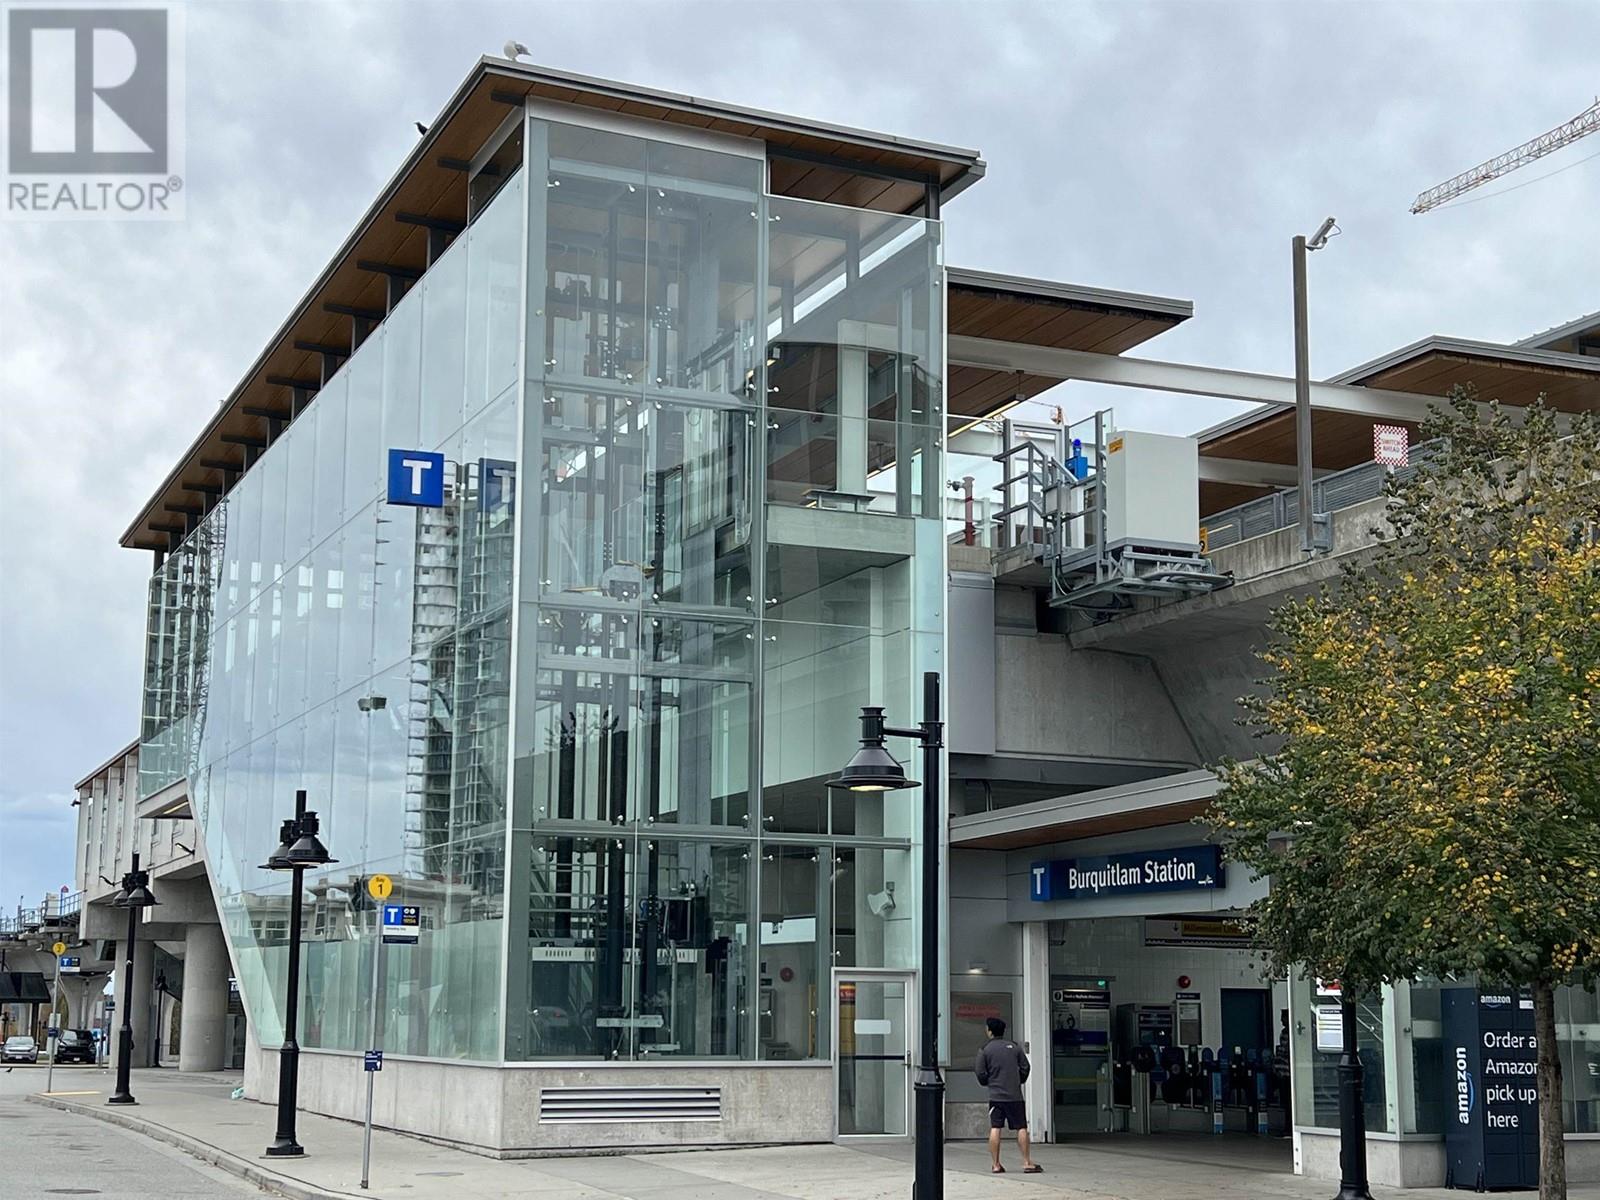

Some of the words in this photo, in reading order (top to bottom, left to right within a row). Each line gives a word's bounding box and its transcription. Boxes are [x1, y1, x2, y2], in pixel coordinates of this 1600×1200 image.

[402, 459, 433, 495] T
[1033, 867, 1045, 895] T
[1069, 863, 1141, 894] Burquitlam
[1144, 857, 1196, 884] Station
[378, 883, 383, 895] 1
[387, 908, 399, 923] T
[1480, 995, 1511, 1003] amazon
[1483, 1031, 1525, 1049] Order
[1456, 1047, 1470, 1124] amazon
[1486, 1084, 1516, 1105] pick
[1518, 1088, 1537, 1105] up
[1487, 1110, 1519, 1128] here
